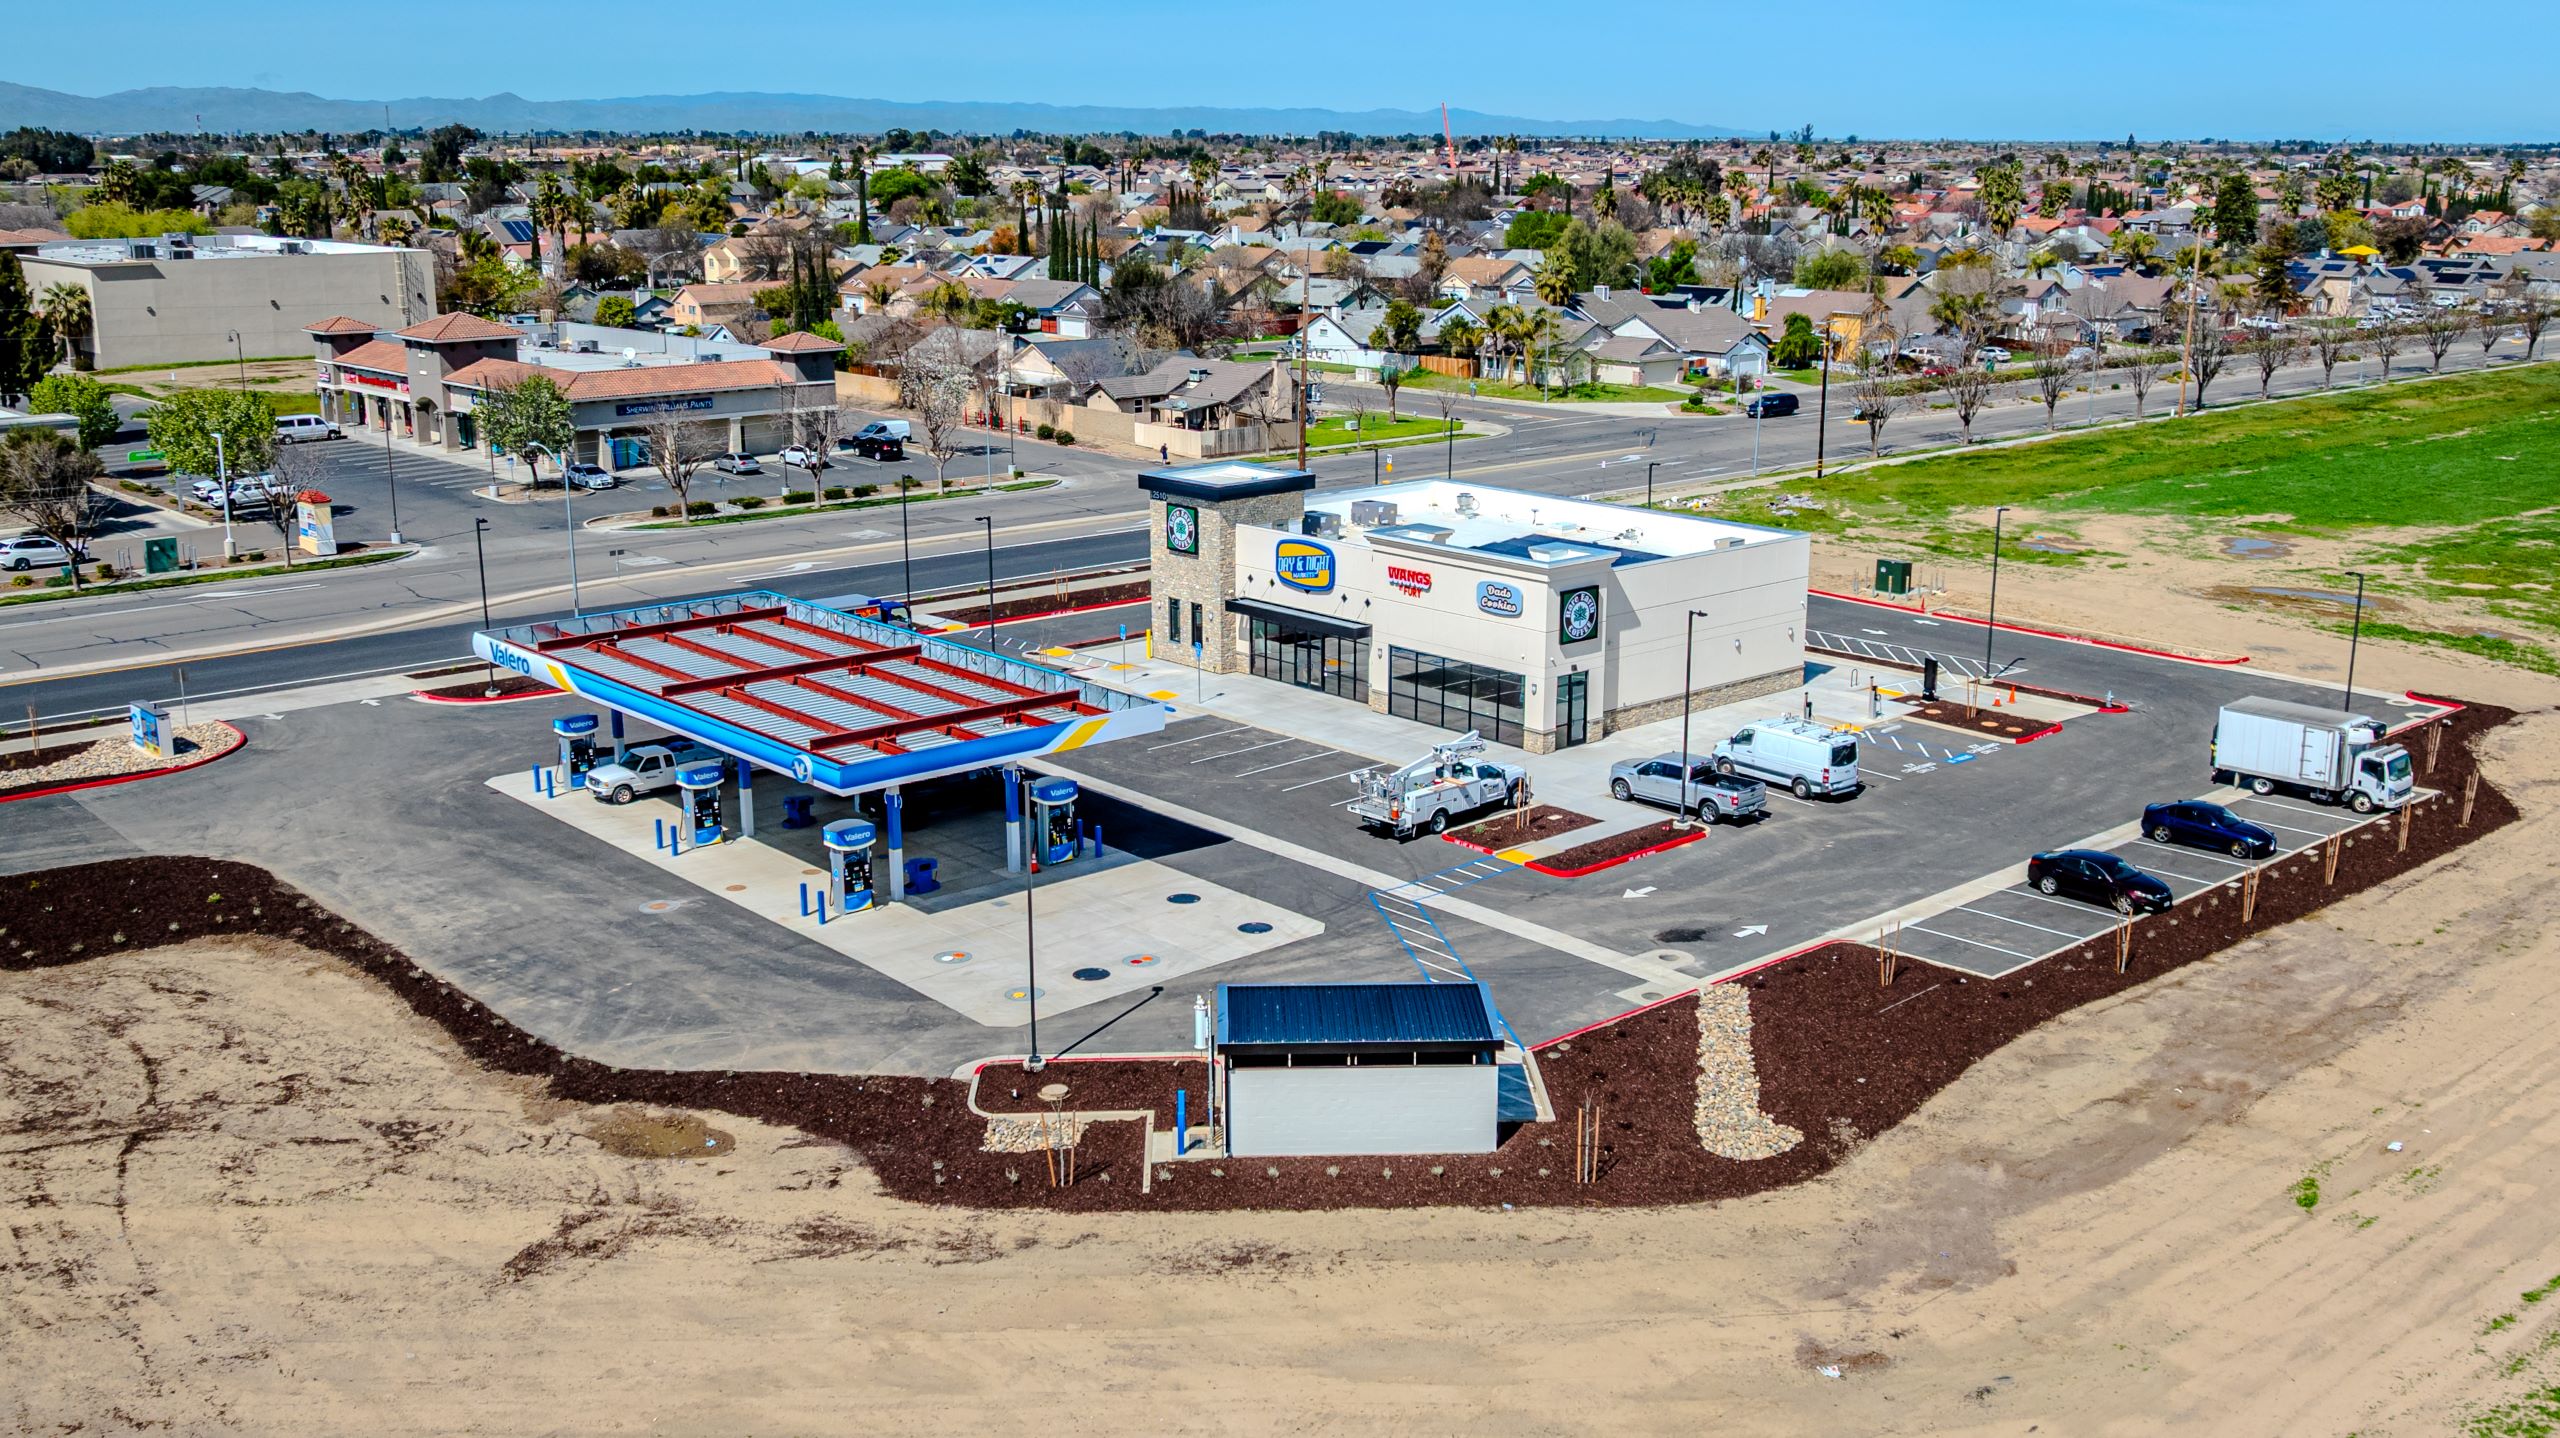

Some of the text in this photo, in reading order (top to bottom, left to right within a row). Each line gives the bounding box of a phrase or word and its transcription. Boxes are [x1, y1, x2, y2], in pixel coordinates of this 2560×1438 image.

[690, 400, 712, 409] PAINTS
[1278, 555, 1330, 573] DAY & NIGHT
[1388, 566, 1431, 586] WANGS
[1403, 585, 1422, 598] FURY
[1487, 584, 1512, 598] Dads
[1481, 596, 1517, 612] Cookies
[490, 641, 531, 675] Valero
[569, 720, 594, 729] Valero
[693, 771, 719, 781] Valero
[1050, 787, 1074, 796] Valero
[844, 831, 871, 841] Valero
